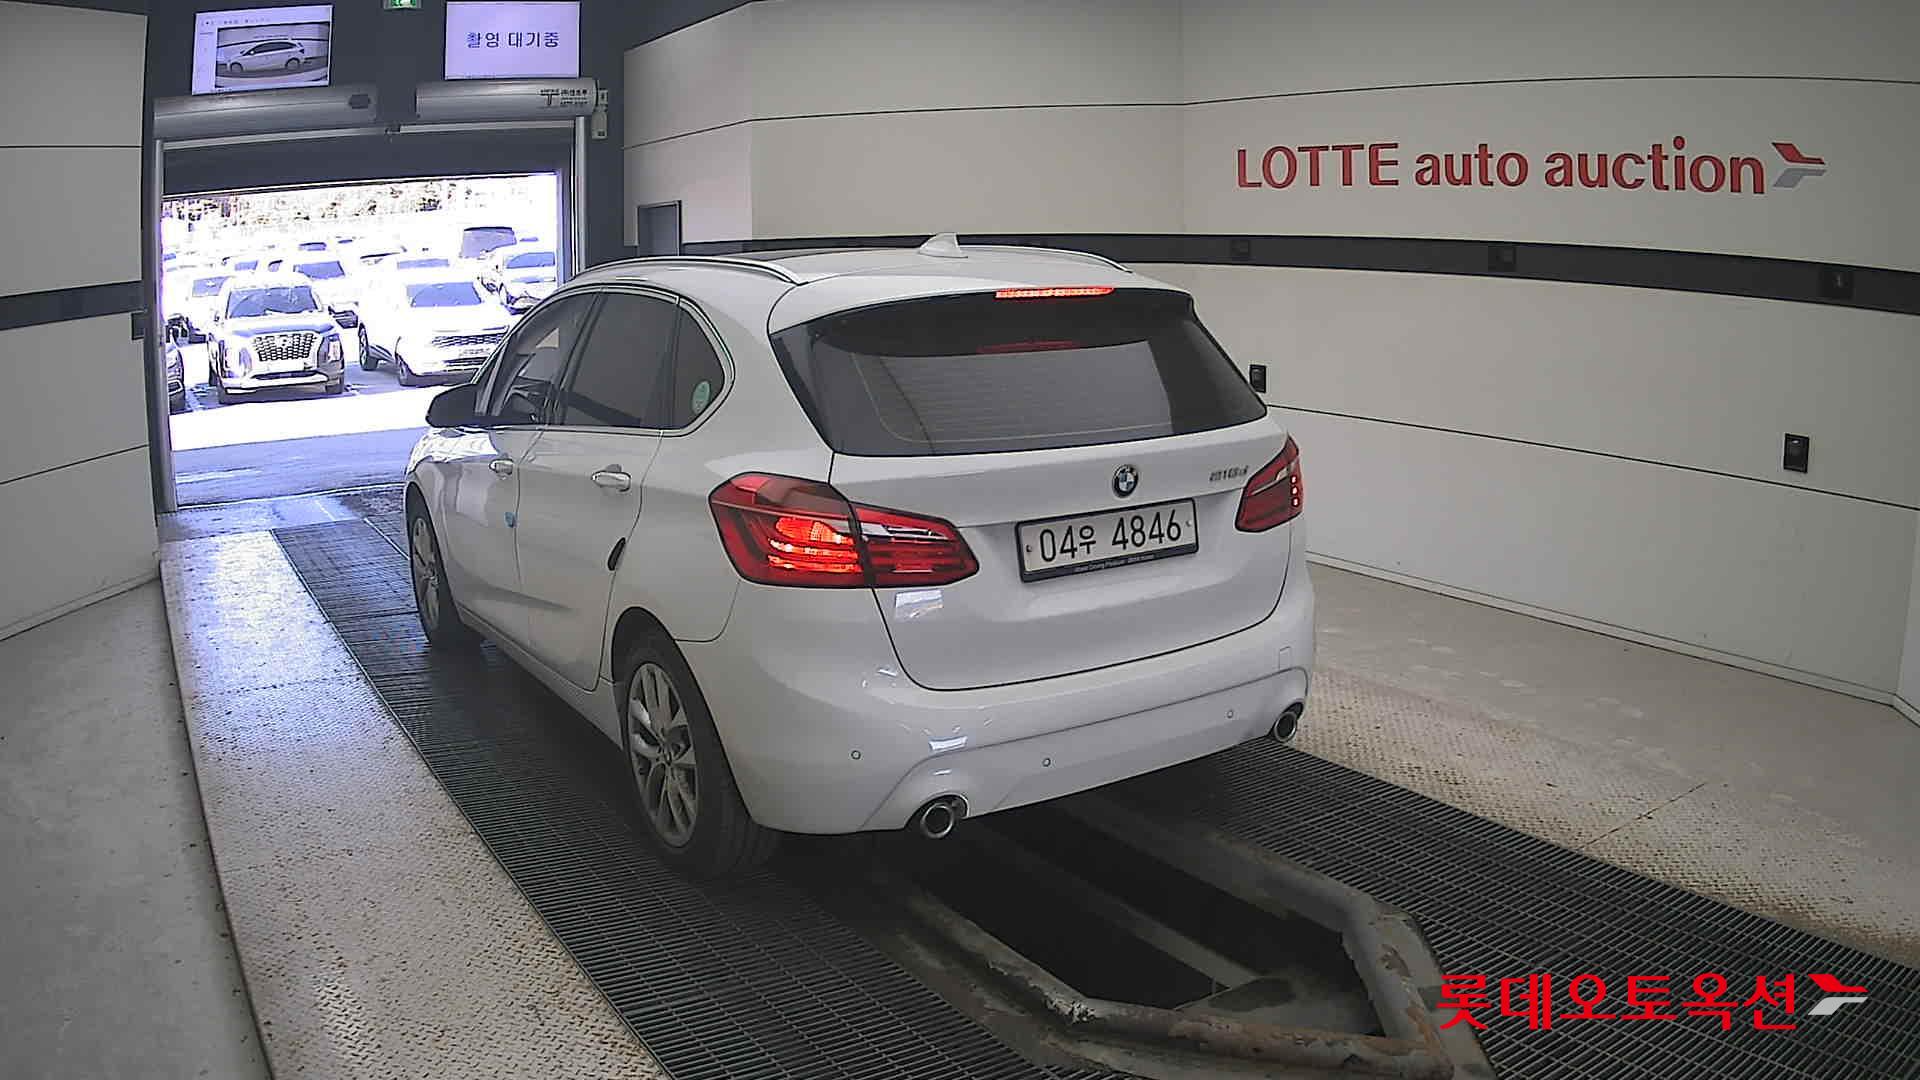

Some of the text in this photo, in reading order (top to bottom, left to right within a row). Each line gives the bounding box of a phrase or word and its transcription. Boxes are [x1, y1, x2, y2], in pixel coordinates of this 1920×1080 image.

[507, 32, 560, 48] 대기중
[1237, 136, 1766, 195] LOTTE auto auction
[1039, 509, 1181, 562] 04우 4846
